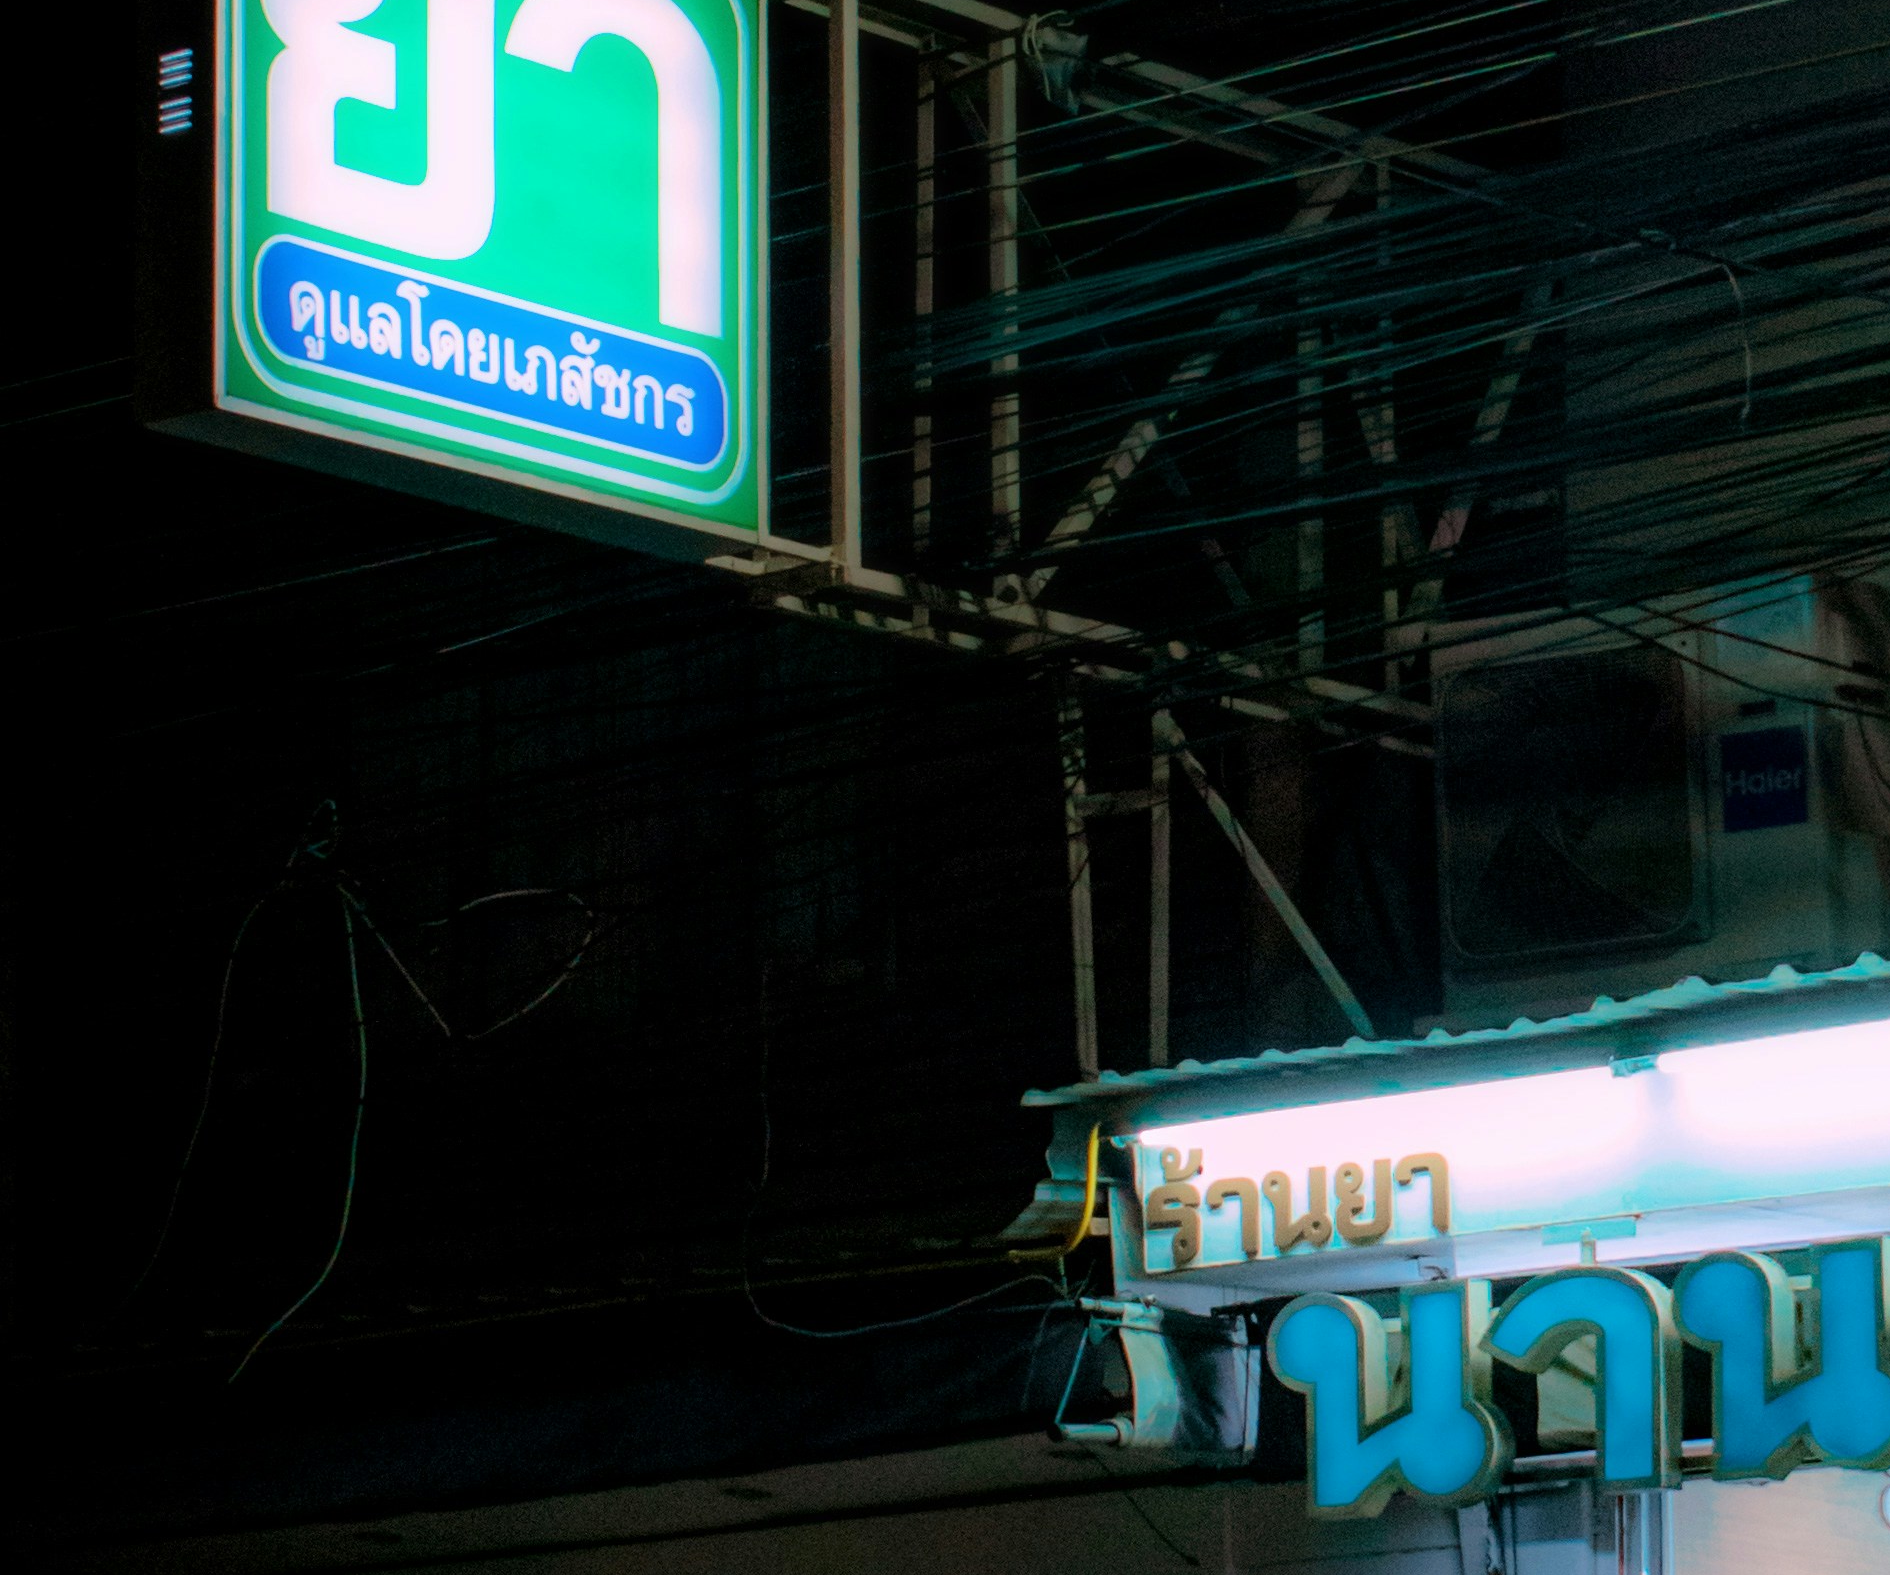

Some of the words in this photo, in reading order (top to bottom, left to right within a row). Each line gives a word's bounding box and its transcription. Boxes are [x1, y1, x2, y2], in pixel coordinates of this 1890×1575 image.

[288, 277, 697, 437] ดูแลโดยเภสัชกร
[1724, 767, 1803, 798] Haier
[1147, 1145, 1450, 1269] ร้านยา
